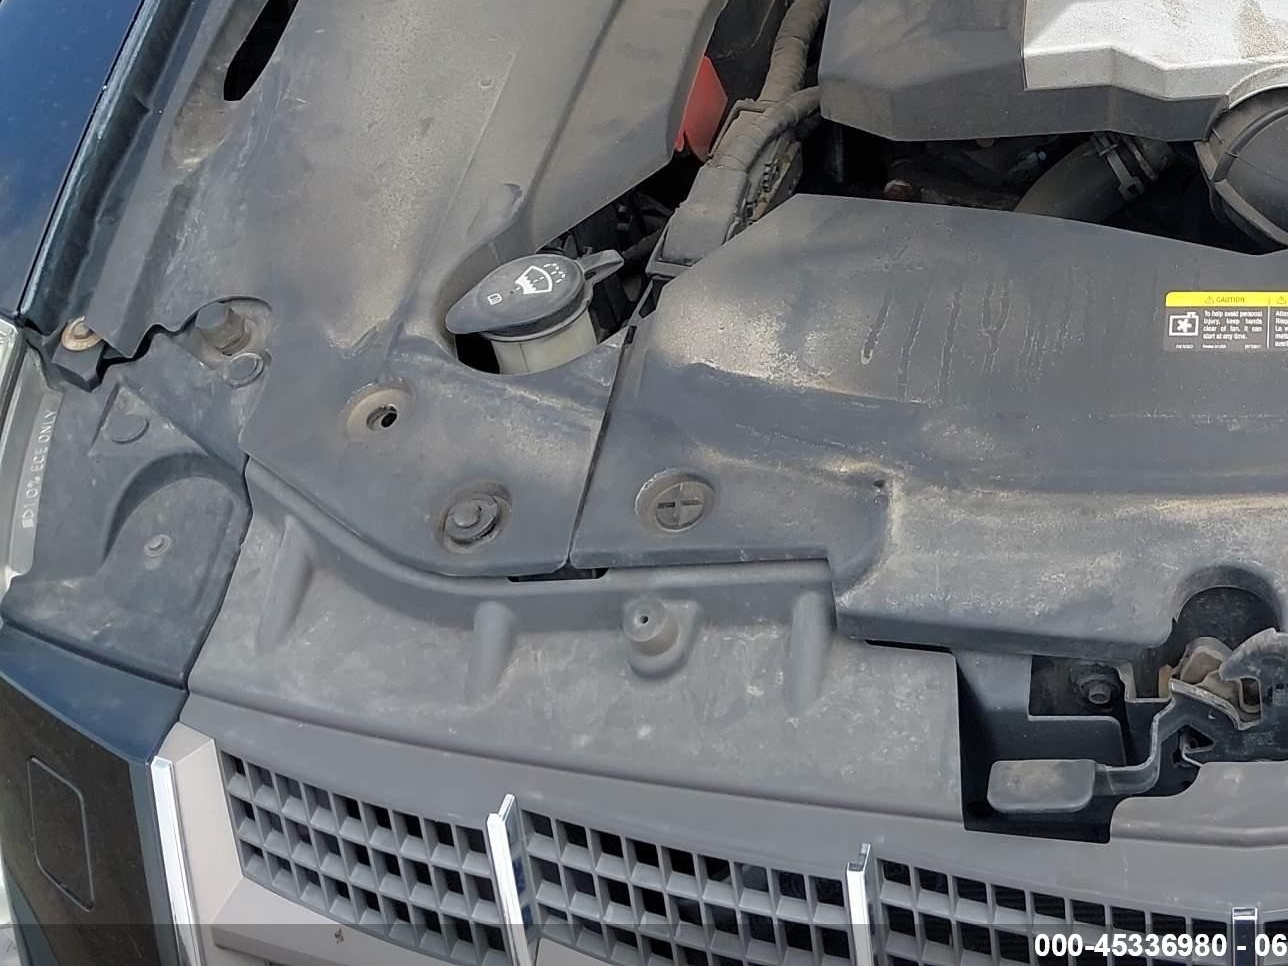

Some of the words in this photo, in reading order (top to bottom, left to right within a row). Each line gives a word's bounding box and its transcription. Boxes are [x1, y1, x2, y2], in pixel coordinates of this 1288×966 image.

[1211, 310, 1223, 318] help
[38, 410, 57, 443] ONLY
[31, 446, 49, 472] ECE
